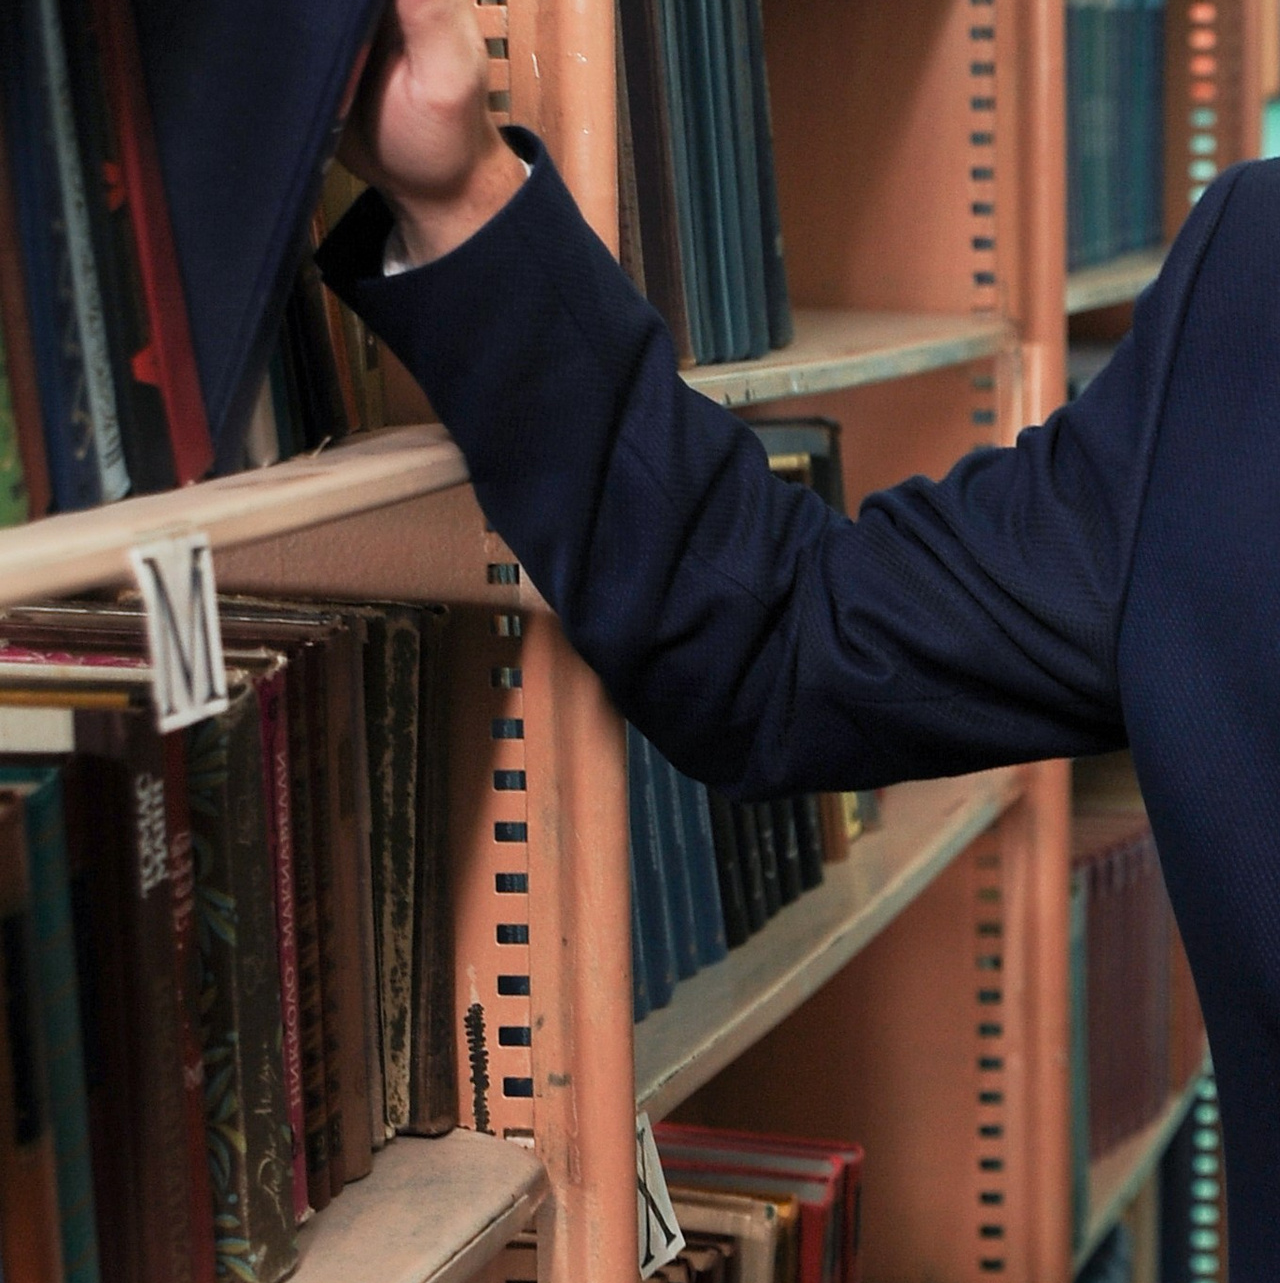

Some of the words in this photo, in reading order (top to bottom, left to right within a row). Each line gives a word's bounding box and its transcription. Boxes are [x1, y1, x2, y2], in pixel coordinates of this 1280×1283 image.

[142, 547, 226, 717] М
[135, 772, 158, 899] ТОМАС
[275, 750, 294, 949] МАКИАВЕЛЛИ
[284, 965, 302, 1109] НИККОЛО
